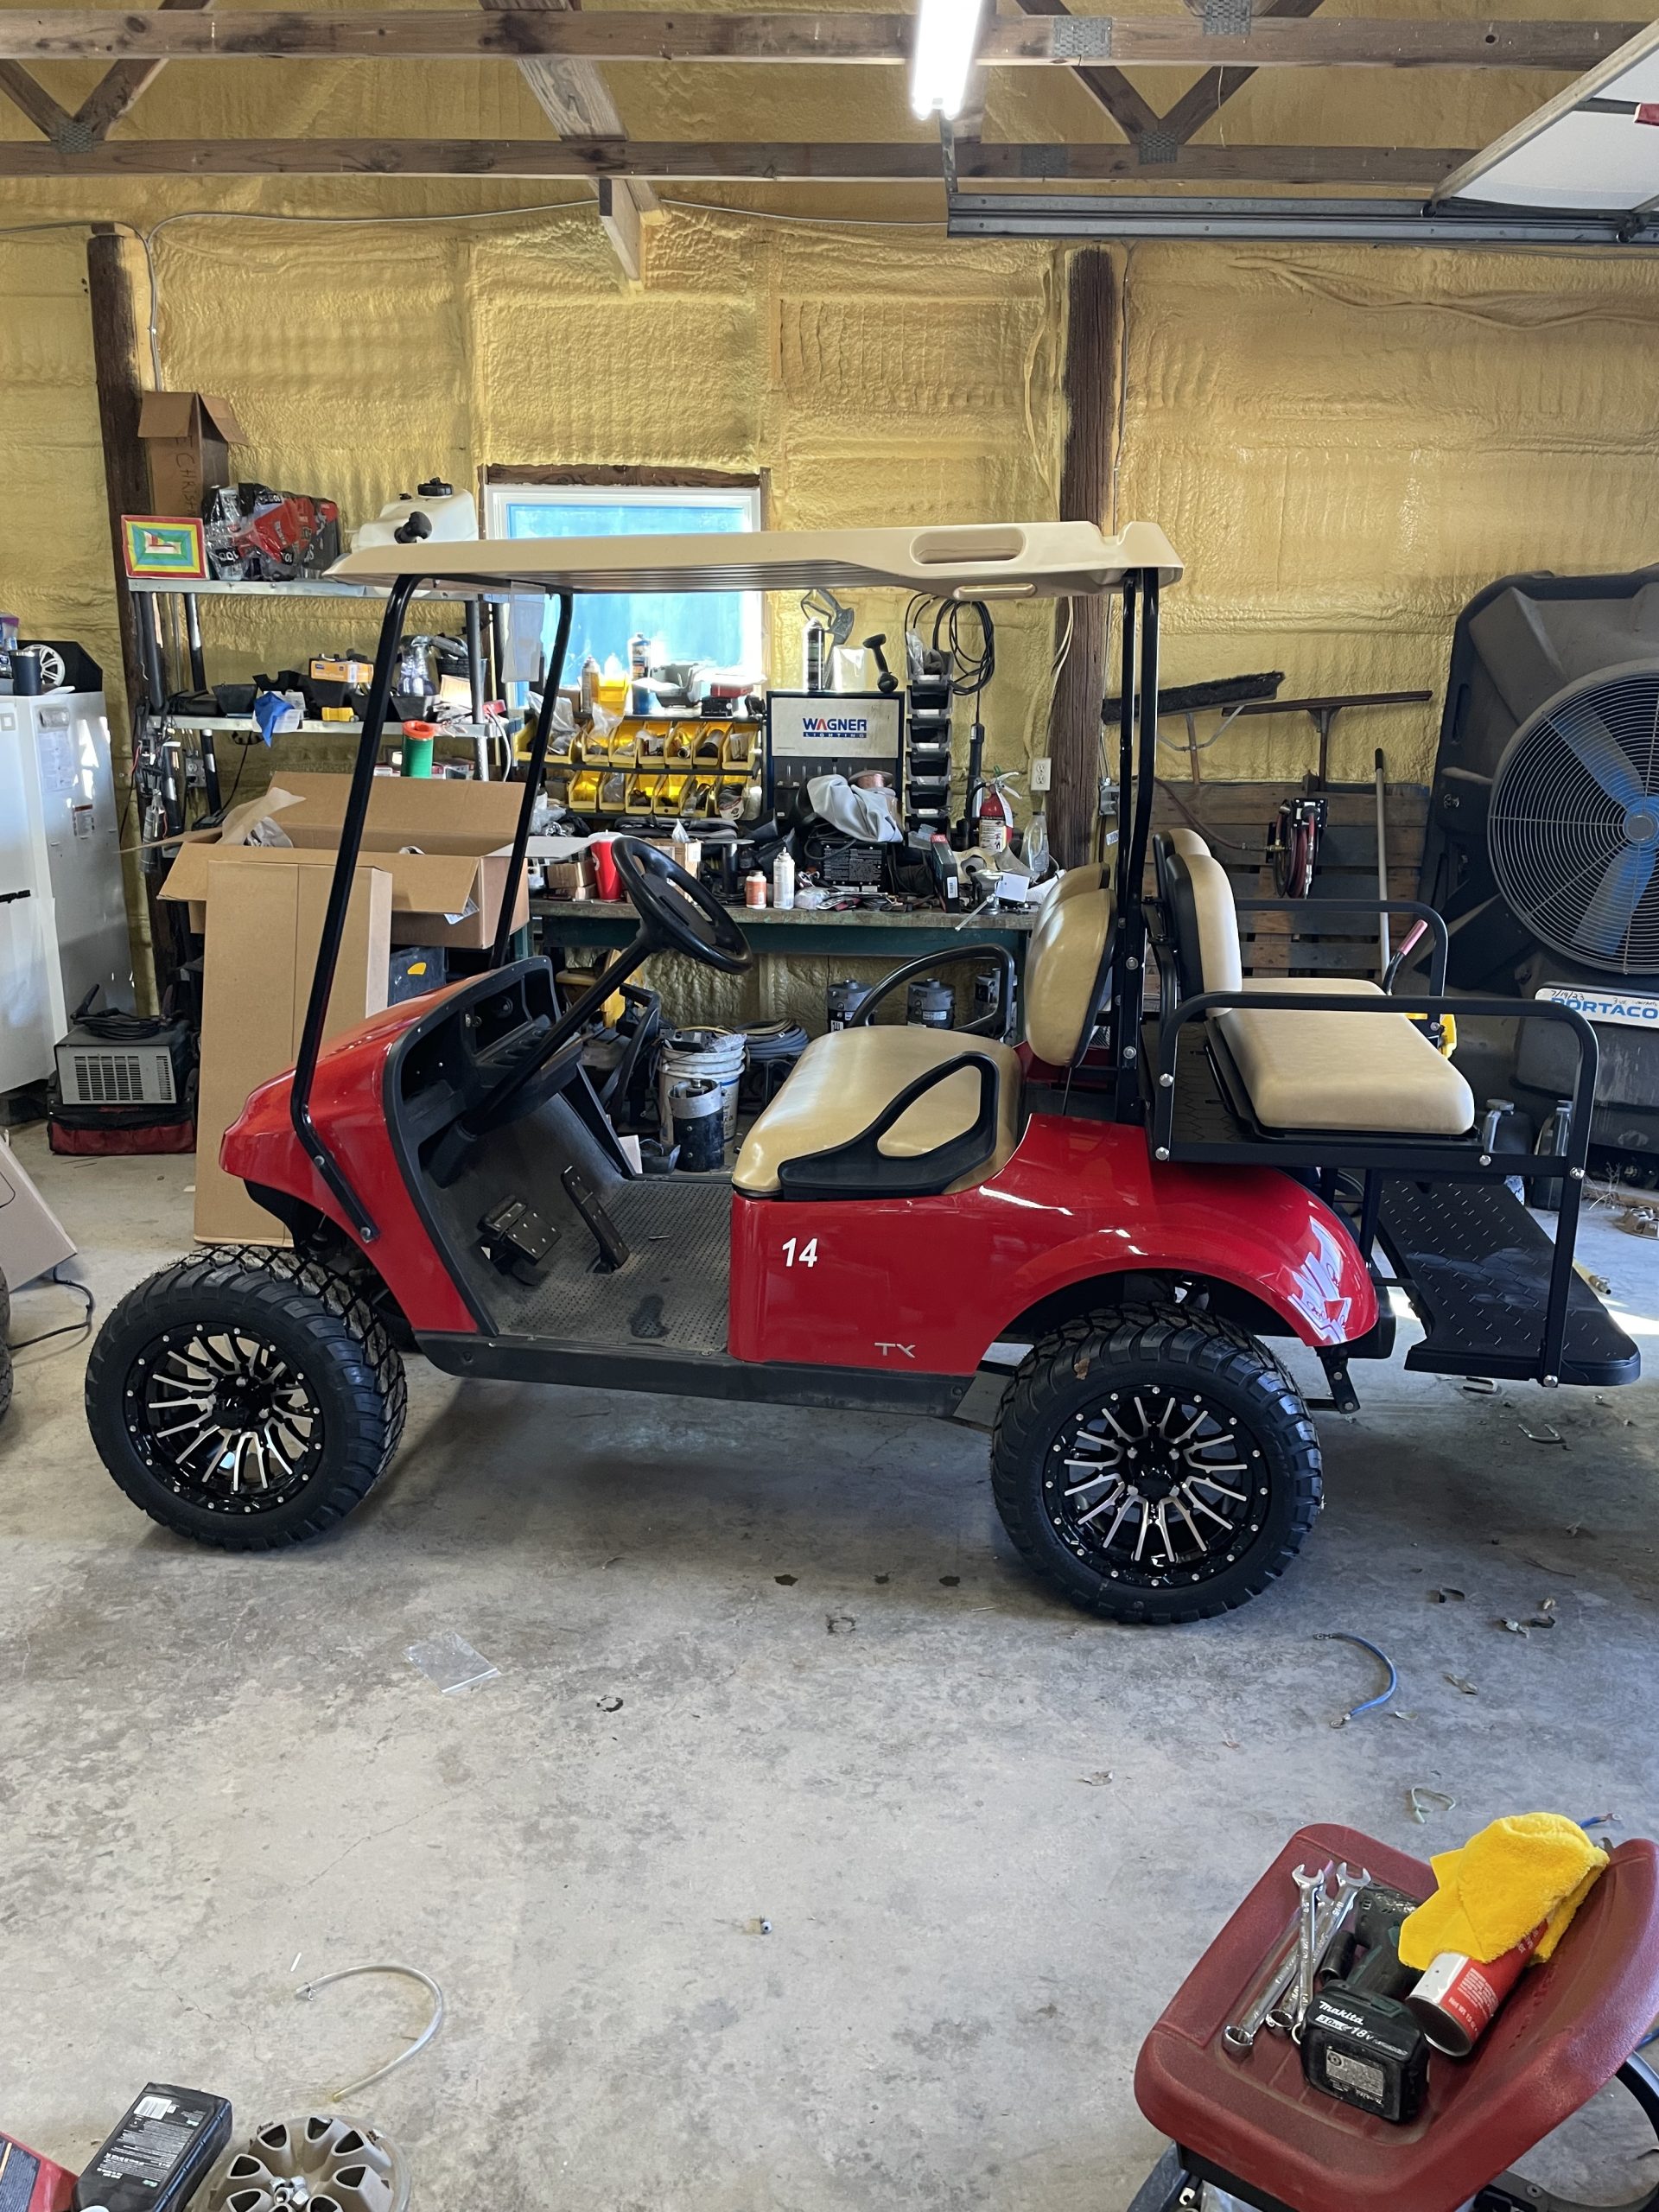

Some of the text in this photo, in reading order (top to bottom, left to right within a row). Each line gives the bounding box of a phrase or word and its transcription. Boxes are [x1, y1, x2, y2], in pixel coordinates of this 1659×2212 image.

[803, 718, 867, 731] WAGNER
[782, 1237, 818, 1268] 14
[874, 1342, 916, 1358] TX
